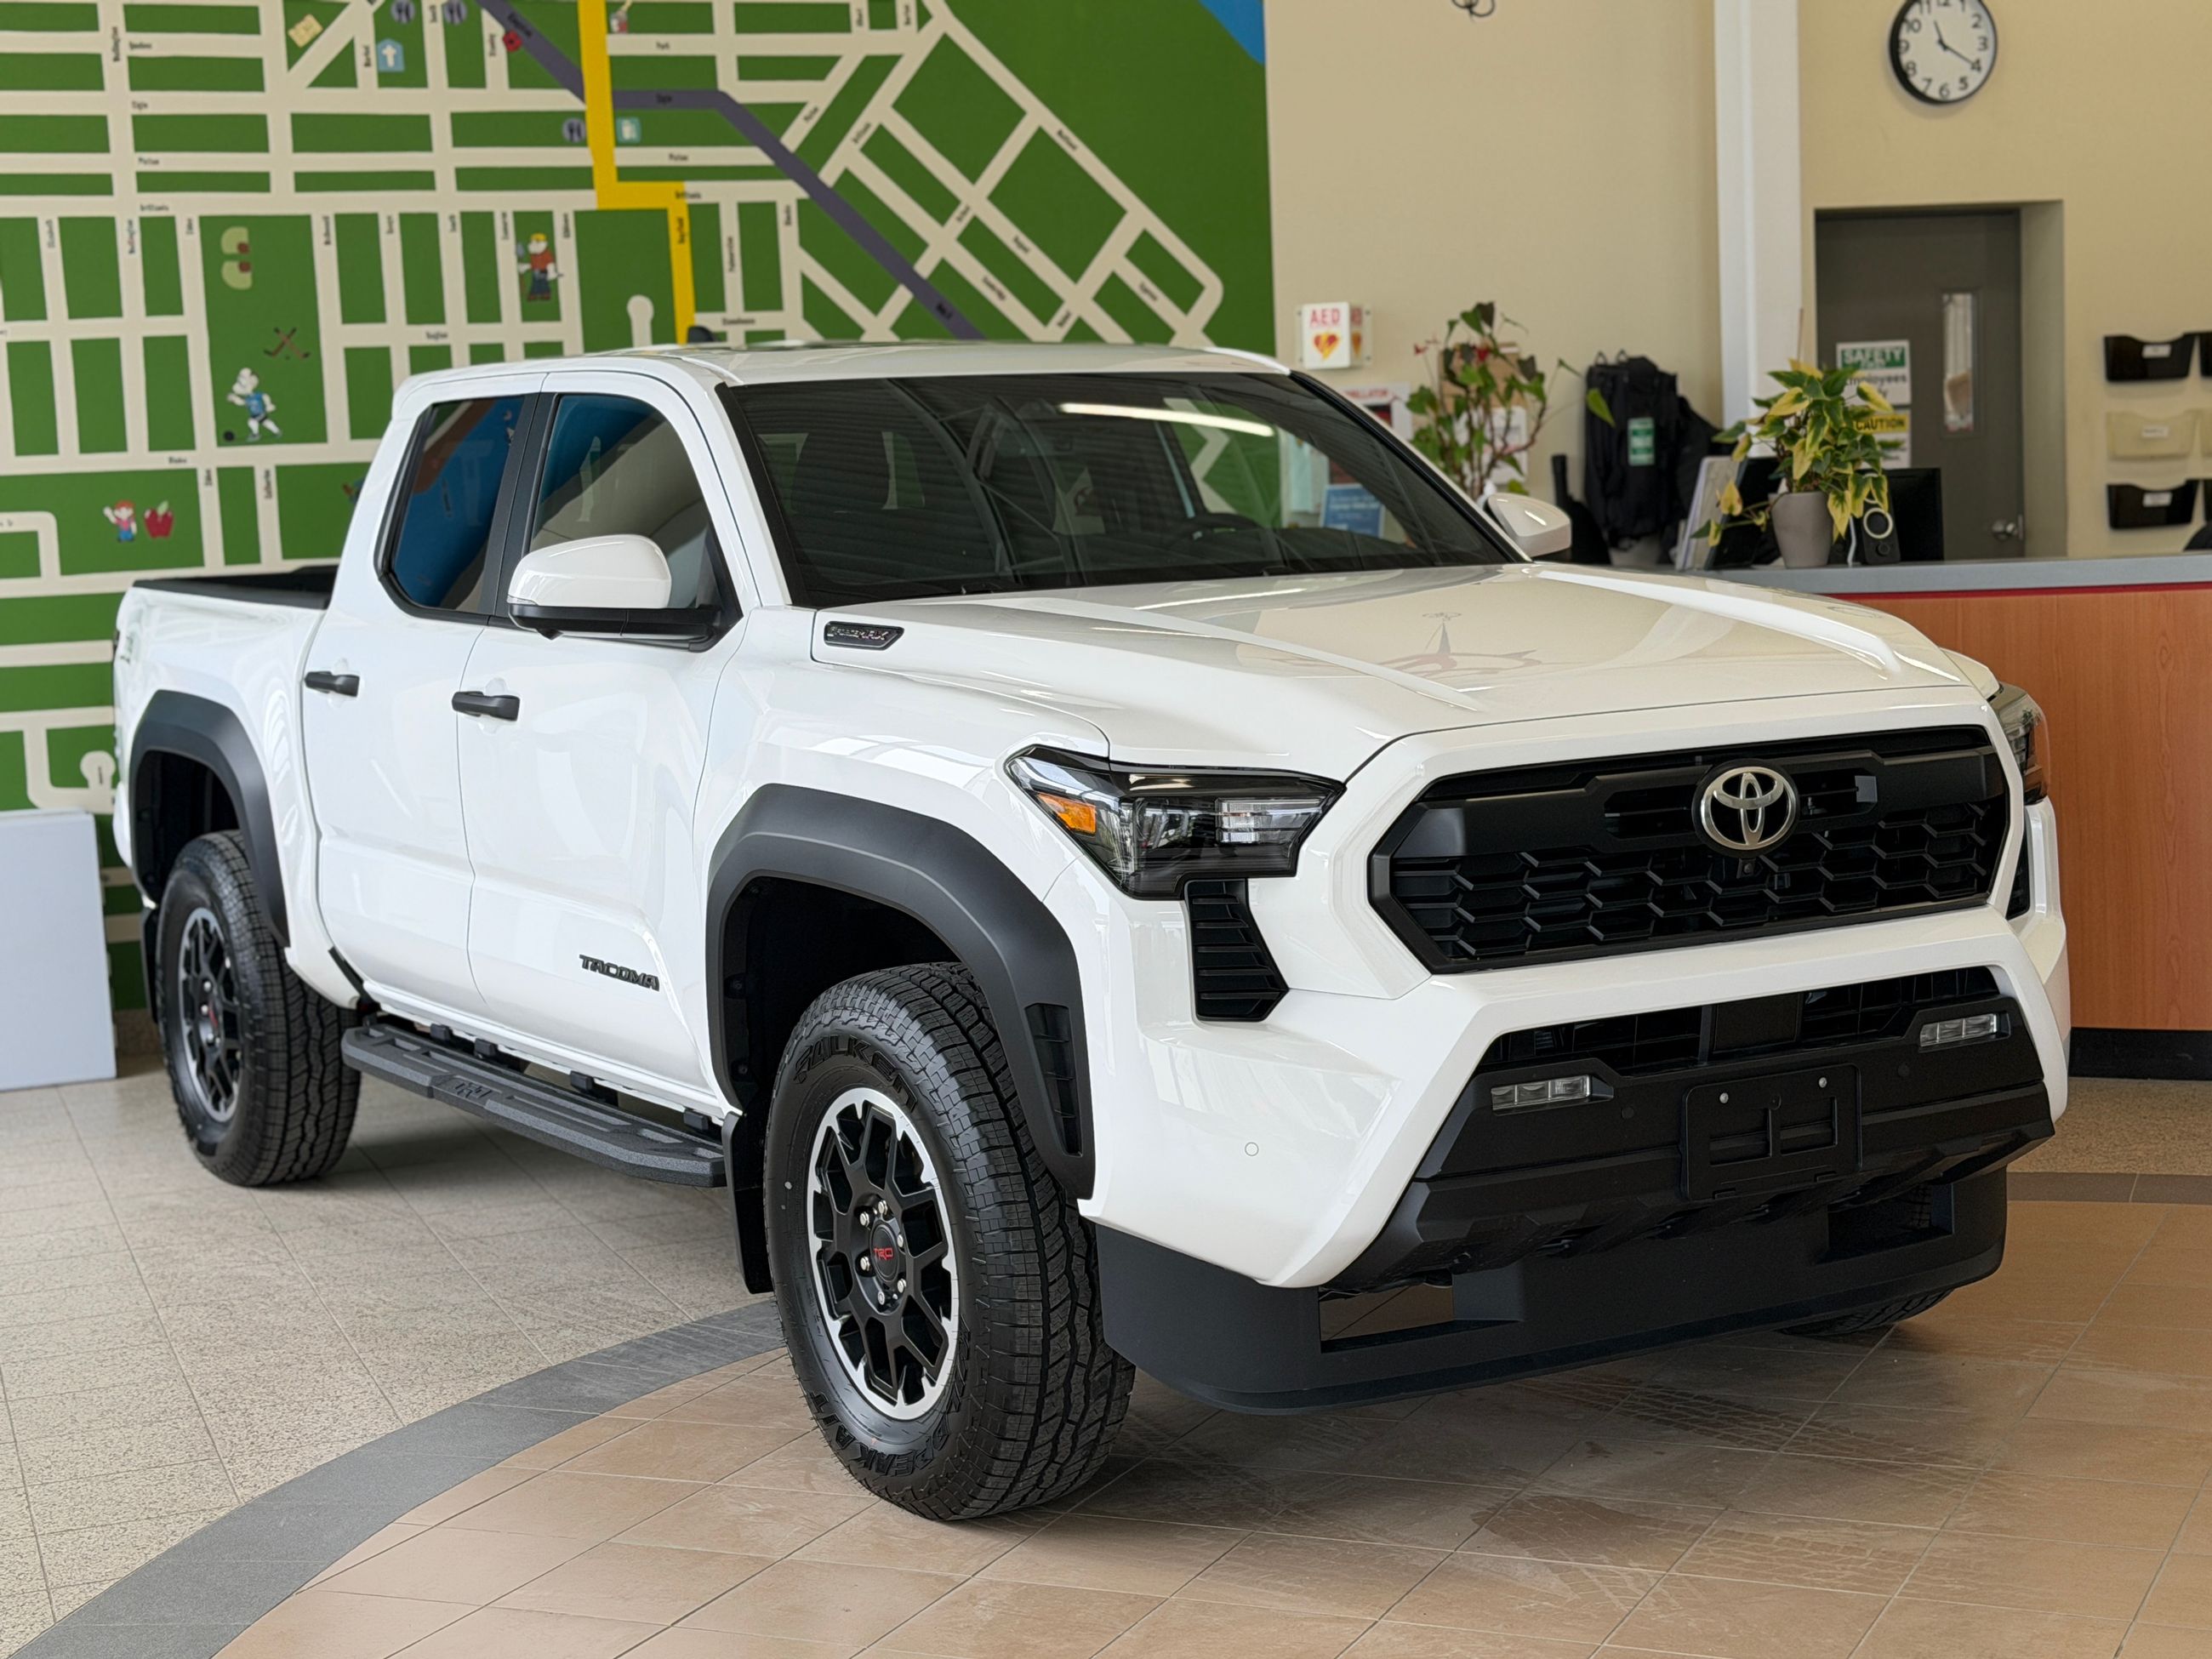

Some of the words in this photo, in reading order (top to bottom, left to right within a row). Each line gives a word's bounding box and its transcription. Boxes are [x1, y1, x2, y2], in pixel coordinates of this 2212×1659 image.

[1904, 19, 1922, 32] 10
[1971, 14, 1982, 29] 2
[1899, 40, 1910, 54] 9
[1977, 36, 1988, 51] 3
[1904, 61, 1917, 77] 8
[1970, 58, 1981, 72] 4
[1922, 77, 1932, 94] 7
[1939, 83, 1950, 100] 6
[1958, 77, 1969, 91] 5
[1309, 308, 1341, 328] AED
[1844, 345, 1903, 364] SAFETY
[1856, 416, 1905, 430] CAUTION
[579, 954, 660, 992] TACOMA
[873, 1246, 894, 1261] TRD
